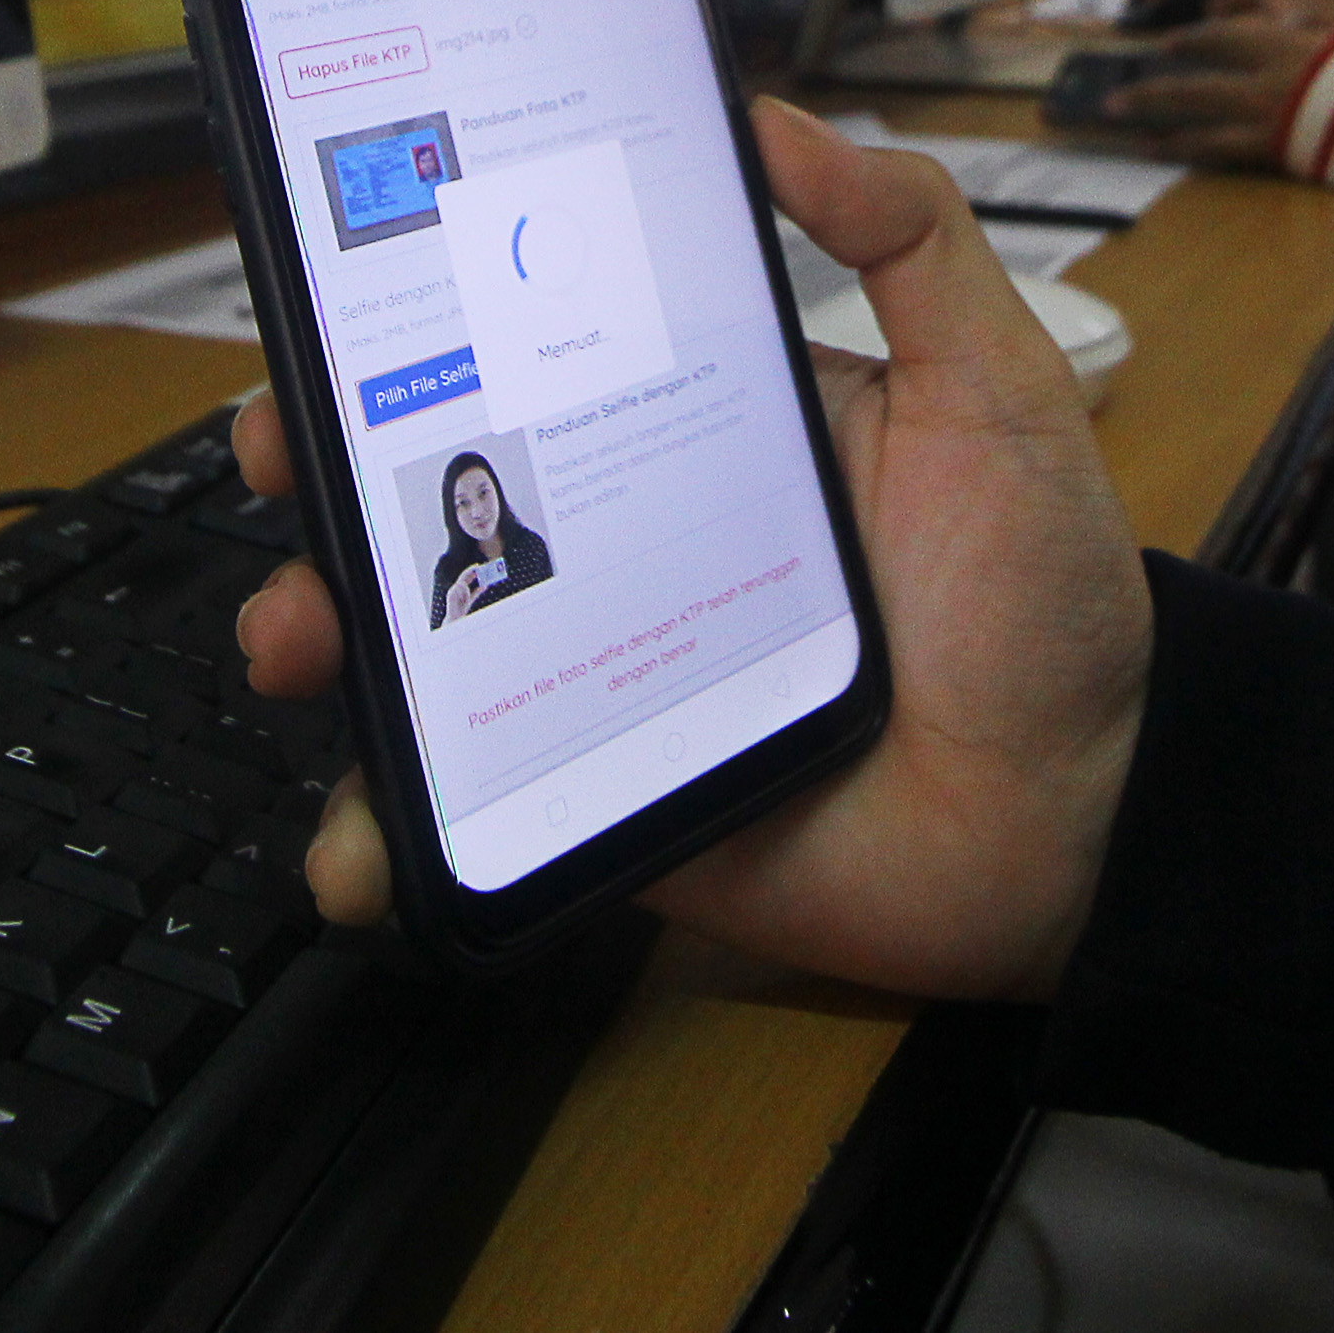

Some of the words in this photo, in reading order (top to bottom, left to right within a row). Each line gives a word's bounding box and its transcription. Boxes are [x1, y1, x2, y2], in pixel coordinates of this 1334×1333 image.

[297, 57, 350, 82] Hapus
[351, 51, 378, 69] File
[380, 43, 412, 63] KTP
[460, 108, 525, 132] Panduan
[560, 88, 587, 108] KTP
[338, 295, 381, 322] Selfie
[384, 278, 442, 310] dengan
[375, 384, 409, 411] Pilih
[410, 377, 438, 400] File
[536, 410, 599, 444] Panduan
[600, 394, 639, 419] Selfie
[641, 374, 690, 403] dengan
[692, 361, 717, 381] KTP
[467, 689, 532, 730] Pastikan
[533, 676, 556, 698] file
[557, 661, 588, 686] foto
[589, 641, 625, 670] selfie
[627, 617, 678, 651] dengan
[679, 600, 705, 622] KTP
[606, 657, 658, 693] dengan
[659, 636, 698, 666] benar
[5, 745, 37, 766] P
[65, 997, 123, 1034] M
